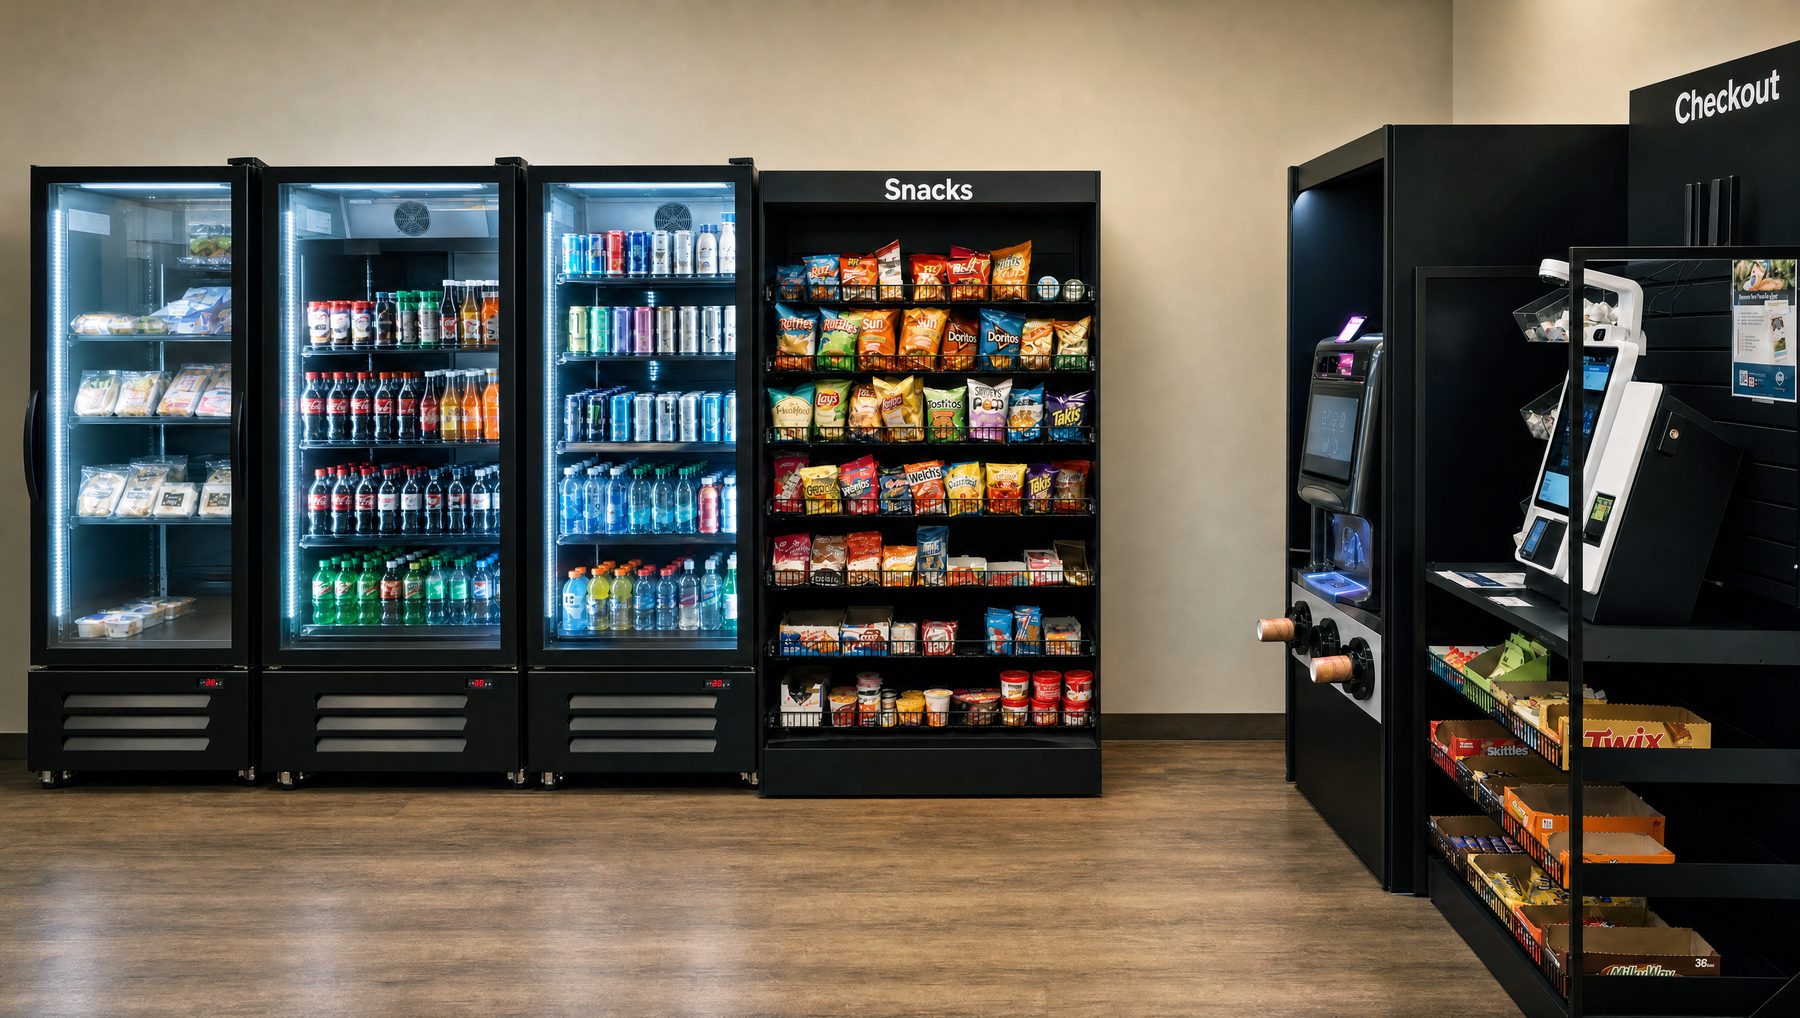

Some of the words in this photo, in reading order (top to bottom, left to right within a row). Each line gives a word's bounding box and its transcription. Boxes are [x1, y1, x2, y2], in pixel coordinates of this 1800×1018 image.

[1675, 69, 1780, 124] Checkout
[884, 178, 974, 201] Snacks
[862, 318, 883, 331] Sun
[948, 331, 977, 344] Doritos
[987, 331, 1019, 344] Doritos
[817, 391, 839, 407] Lay's
[927, 398, 962, 410] Tostitos
[1052, 405, 1081, 426] Takis
[908, 467, 942, 483] Welch's
[1027, 473, 1052, 495] Takis
[1583, 725, 1665, 748] Twix
[1487, 745, 1529, 757] Skittles
[1694, 958, 1708, 968] 36
